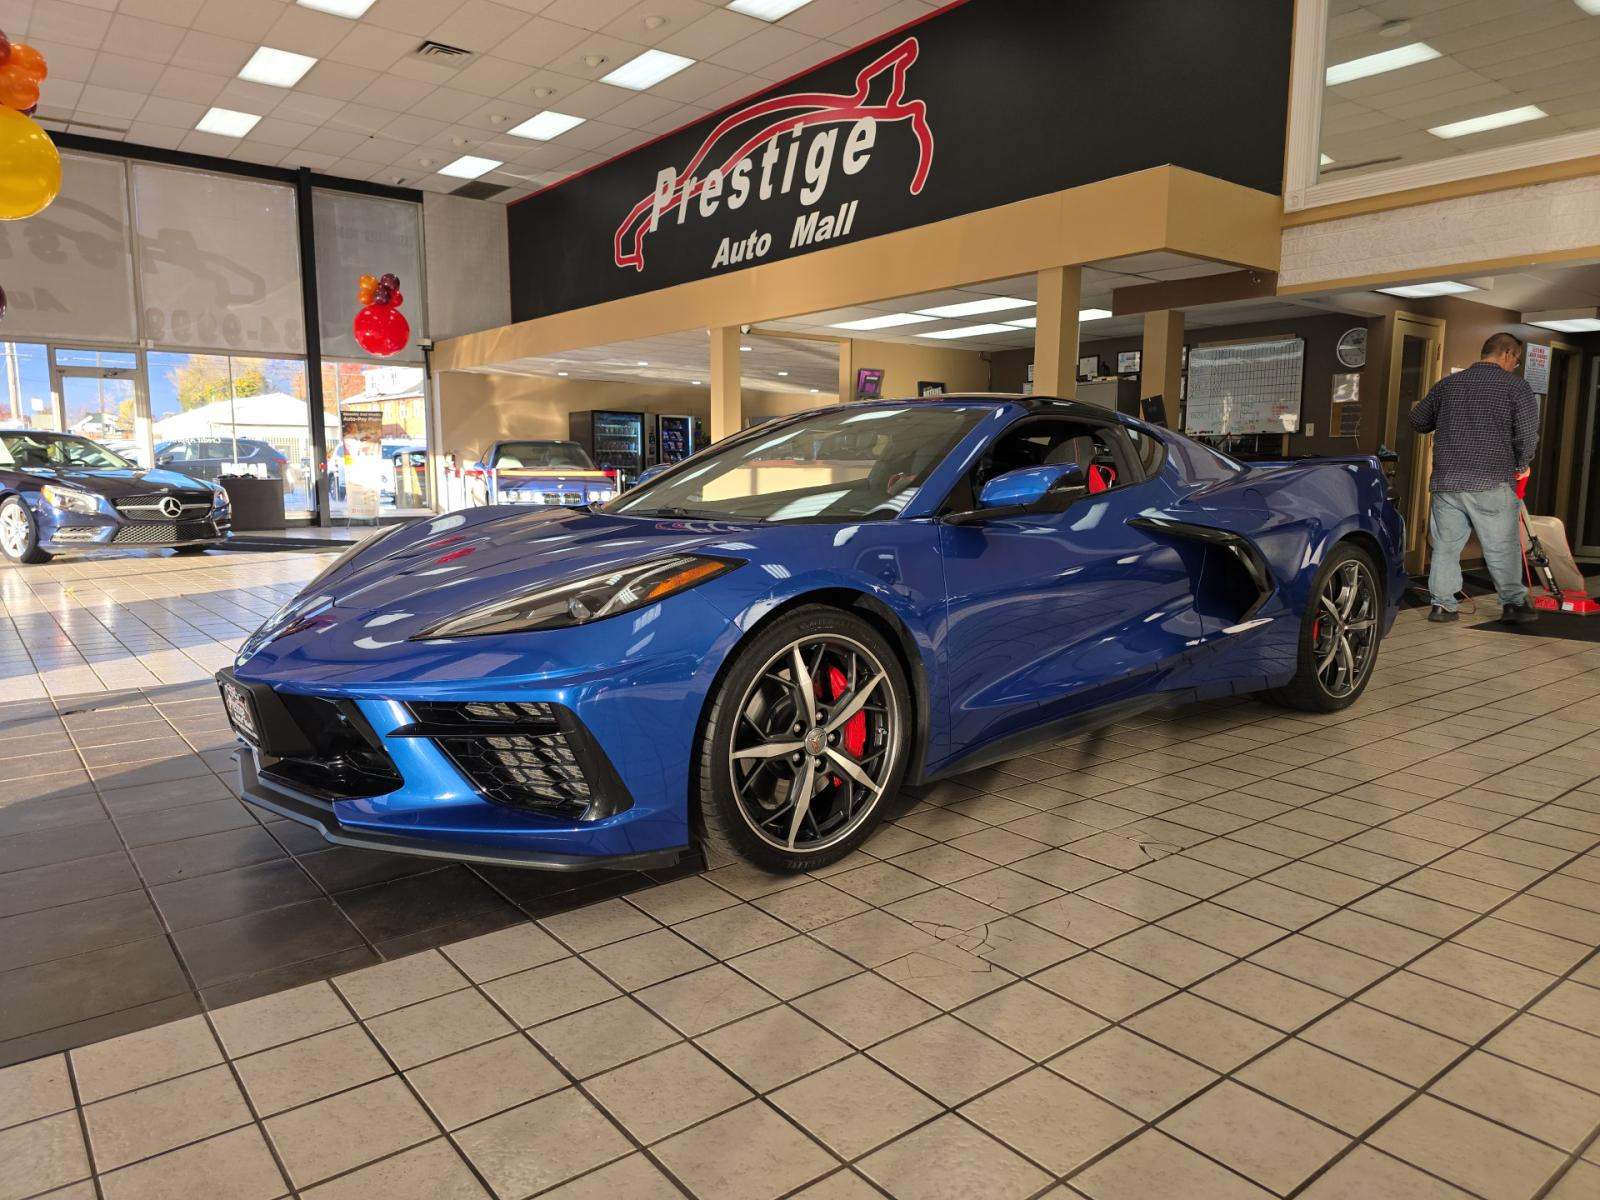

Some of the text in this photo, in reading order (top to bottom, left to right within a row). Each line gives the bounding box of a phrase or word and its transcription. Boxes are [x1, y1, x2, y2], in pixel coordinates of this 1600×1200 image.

[649, 116, 877, 232] Prestige
[711, 200, 858, 269] Auto Mall
